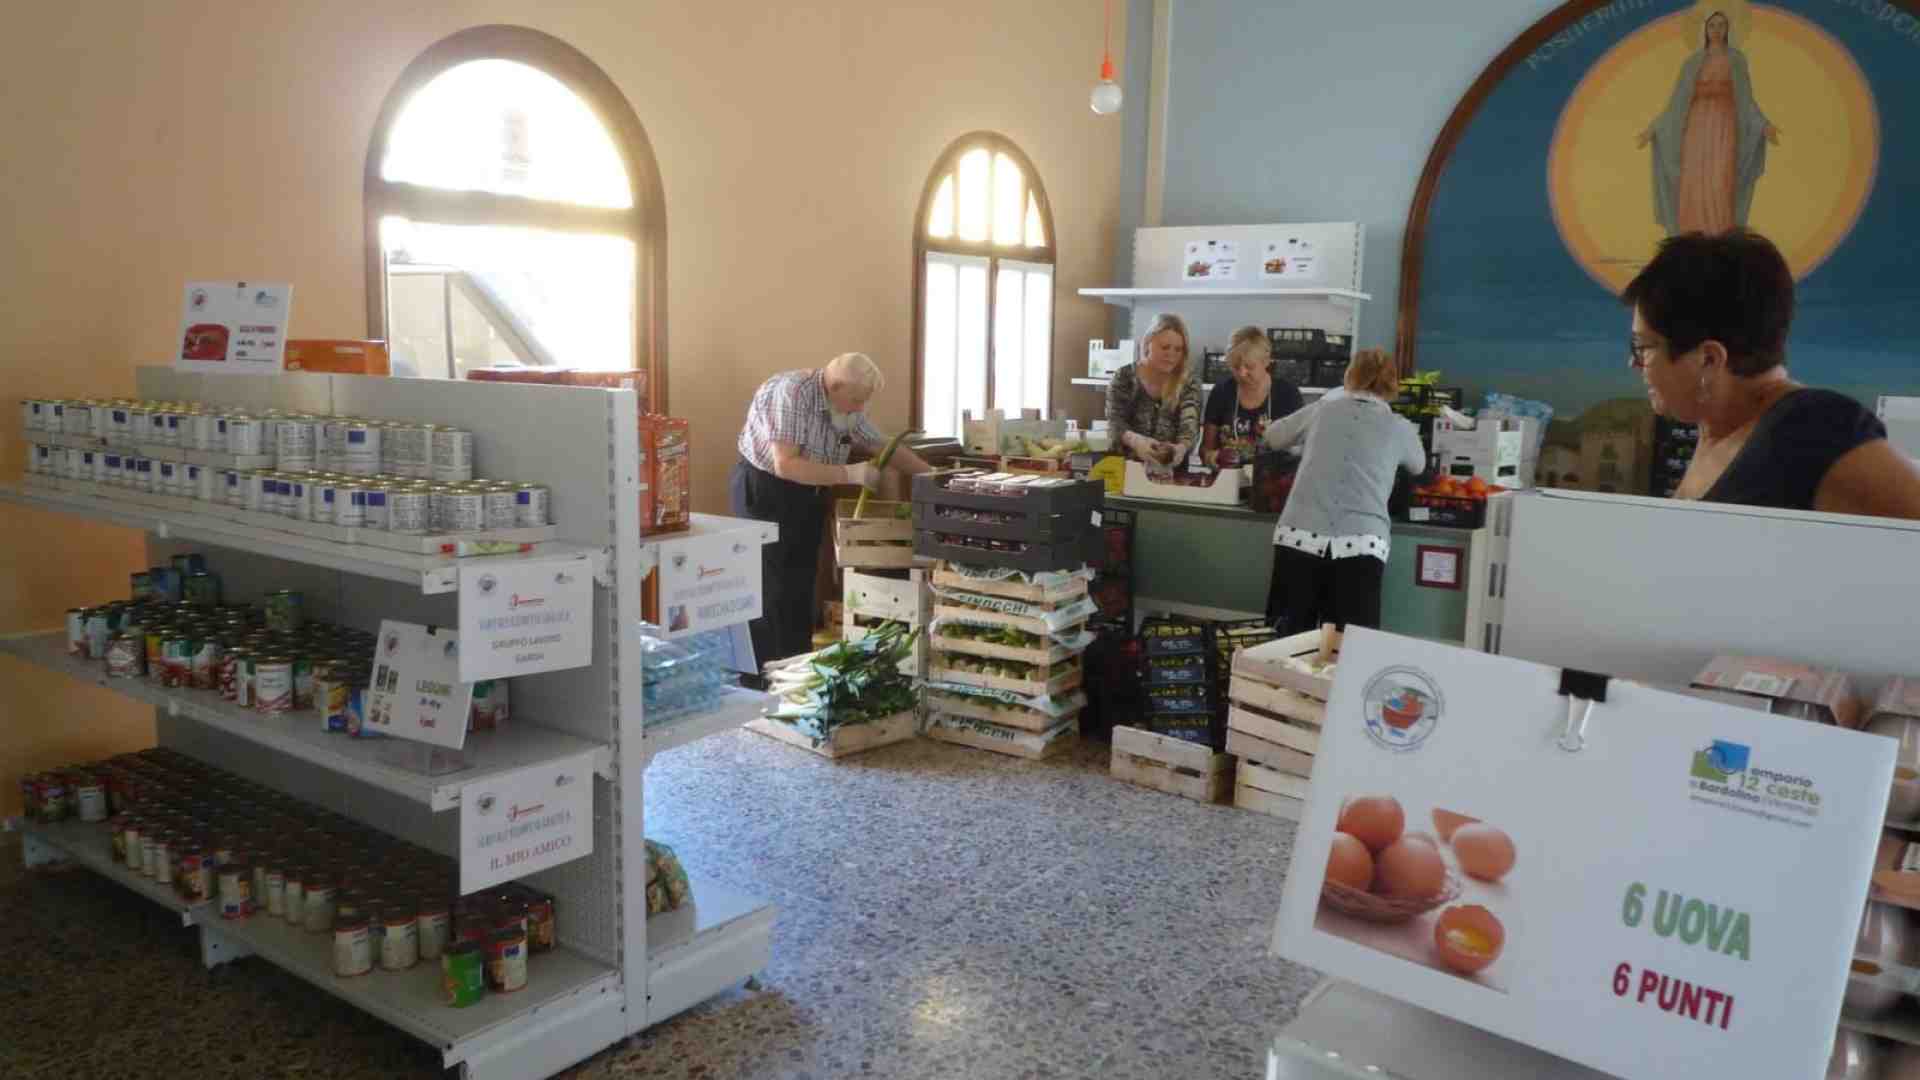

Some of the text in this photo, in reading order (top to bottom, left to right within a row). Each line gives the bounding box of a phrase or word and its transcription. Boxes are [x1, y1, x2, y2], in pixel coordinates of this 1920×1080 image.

[1622, 881, 1751, 961] 6 UOVA
[1612, 962, 1735, 1031] 6 PUNTI
